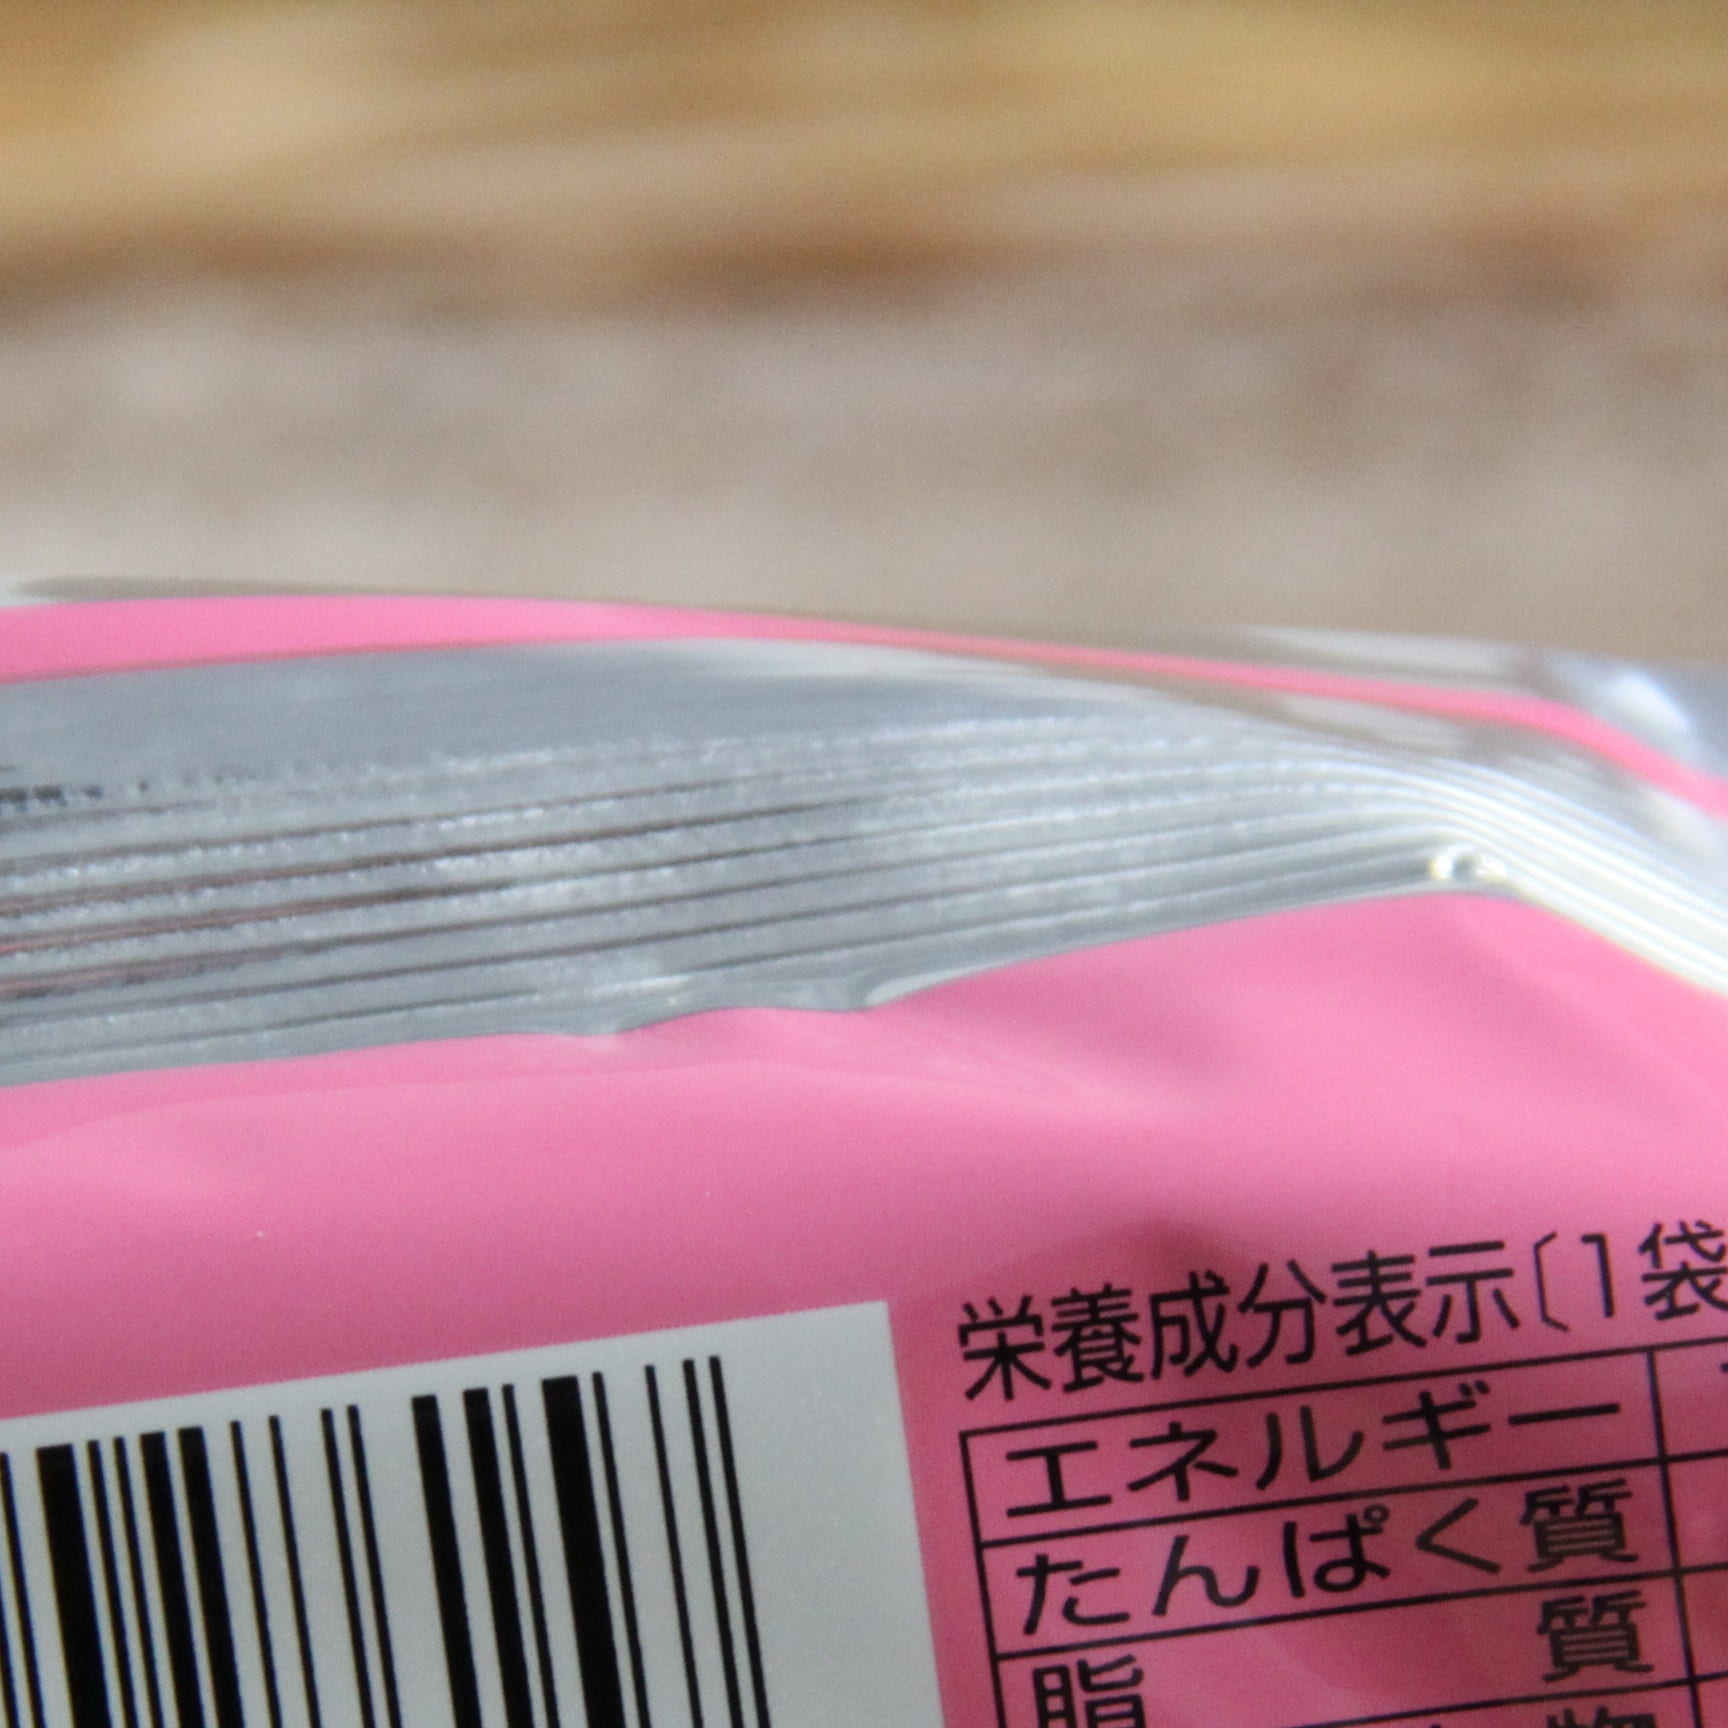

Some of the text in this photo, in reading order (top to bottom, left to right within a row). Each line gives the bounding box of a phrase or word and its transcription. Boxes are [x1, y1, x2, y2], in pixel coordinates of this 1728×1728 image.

[1003, 1381, 1622, 1521] エネルギー
[1016, 1477, 1637, 1637] たんぱく質
[1537, 1587, 1656, 1683] 質
